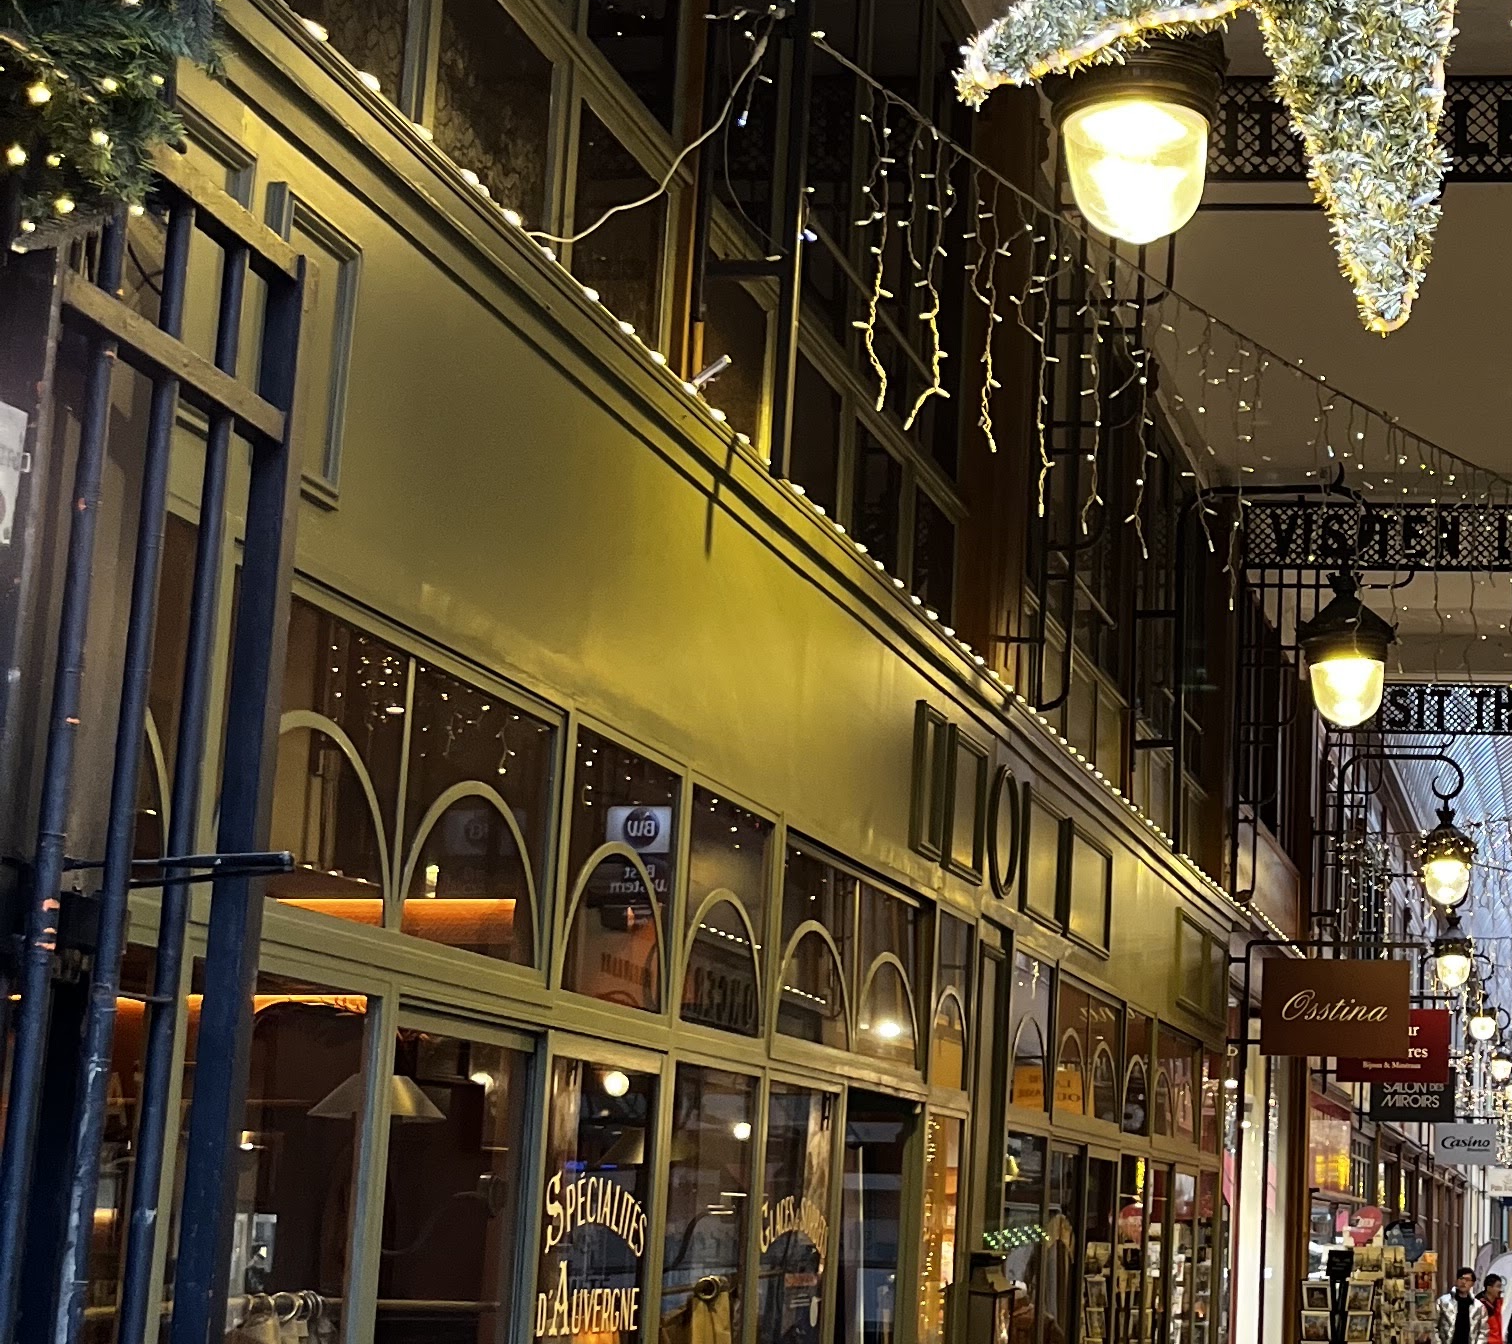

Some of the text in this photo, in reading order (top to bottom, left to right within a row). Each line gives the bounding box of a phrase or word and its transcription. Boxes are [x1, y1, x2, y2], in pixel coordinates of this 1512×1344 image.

[1281, 989, 1388, 1022] Osstina
[1383, 1082, 1426, 1093] SALON
[1380, 1095, 1440, 1107] MIROIRS
[1441, 1135, 1491, 1150] Casino
[544, 1170, 648, 1257] SPÉCIALITÉS
